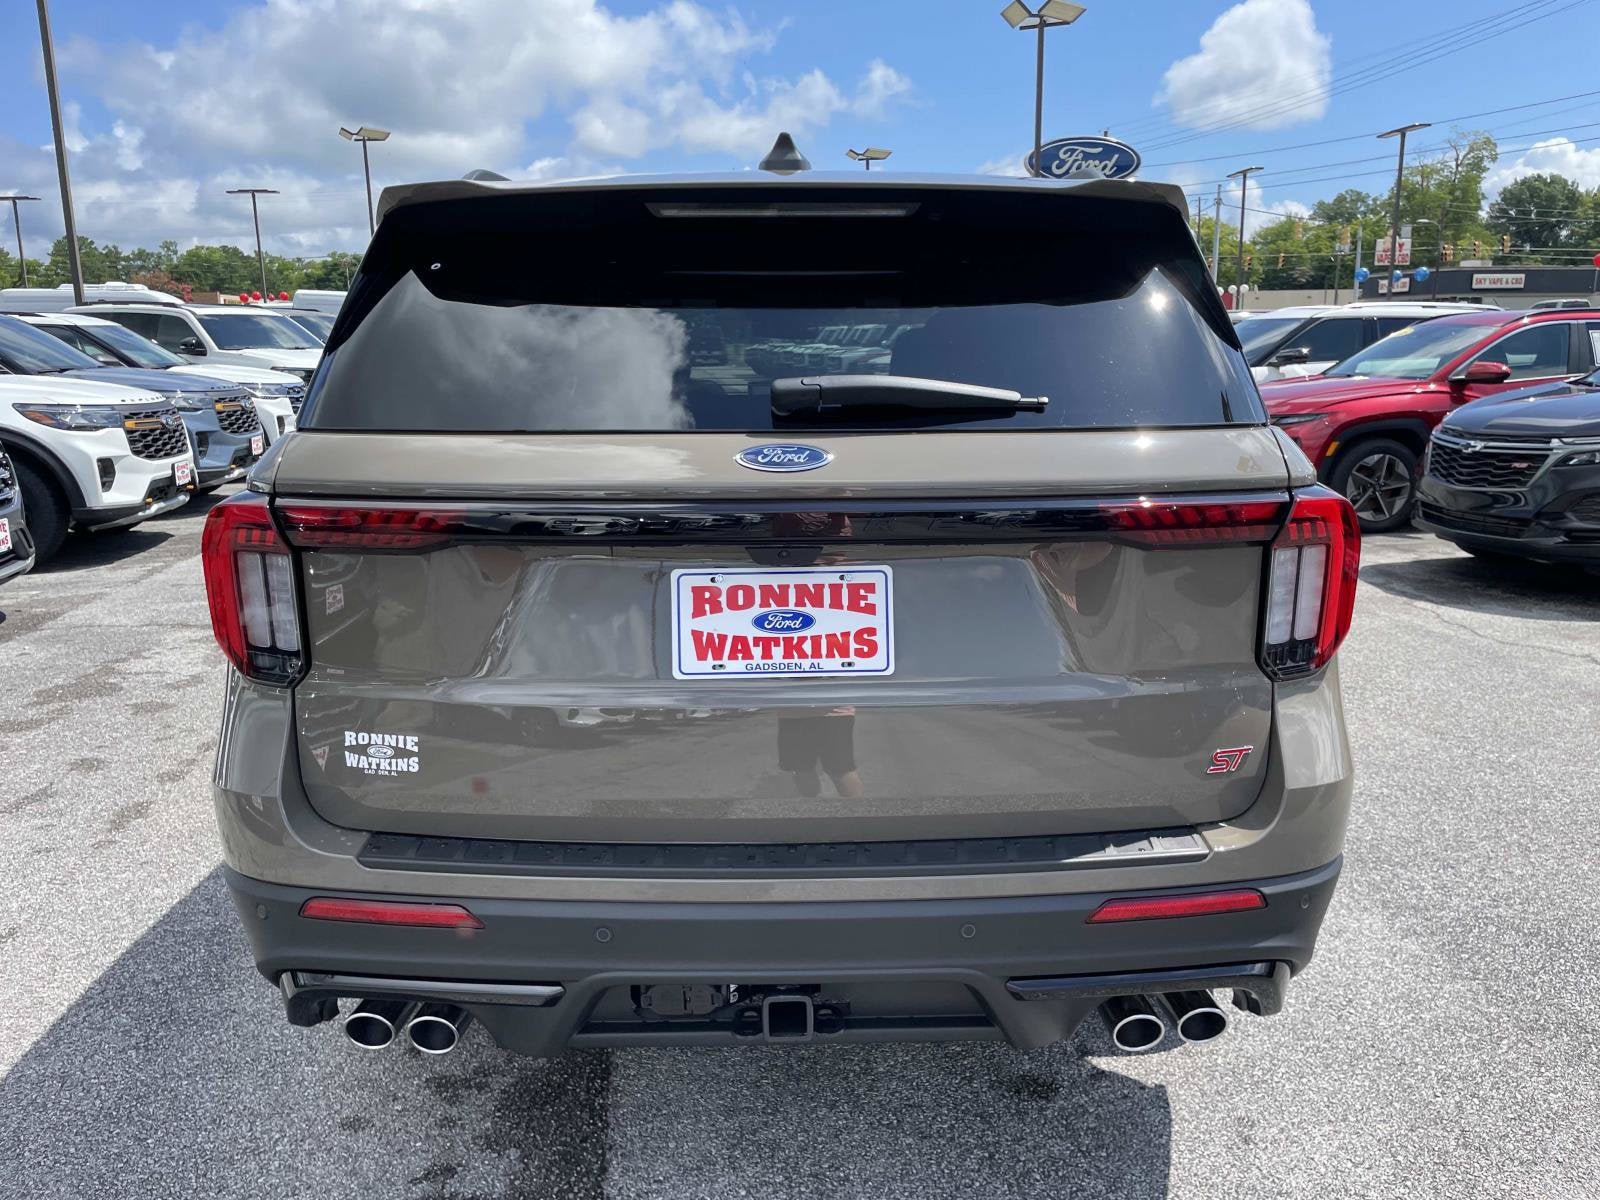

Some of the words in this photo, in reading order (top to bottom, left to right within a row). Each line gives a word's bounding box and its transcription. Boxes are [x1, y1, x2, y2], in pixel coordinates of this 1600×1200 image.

[1051, 145, 1120, 176] Ford
[757, 447, 810, 463] Ford
[690, 582, 877, 619] RONNIE
[763, 612, 804, 629] Ford
[690, 626, 879, 661] WATKINS
[745, 662, 806, 672] GADSDEN,
[809, 662, 825, 670] AL
[344, 731, 419, 753] RONNIE
[344, 751, 420, 773] WATKINS
[1207, 745, 1254, 773] ST
